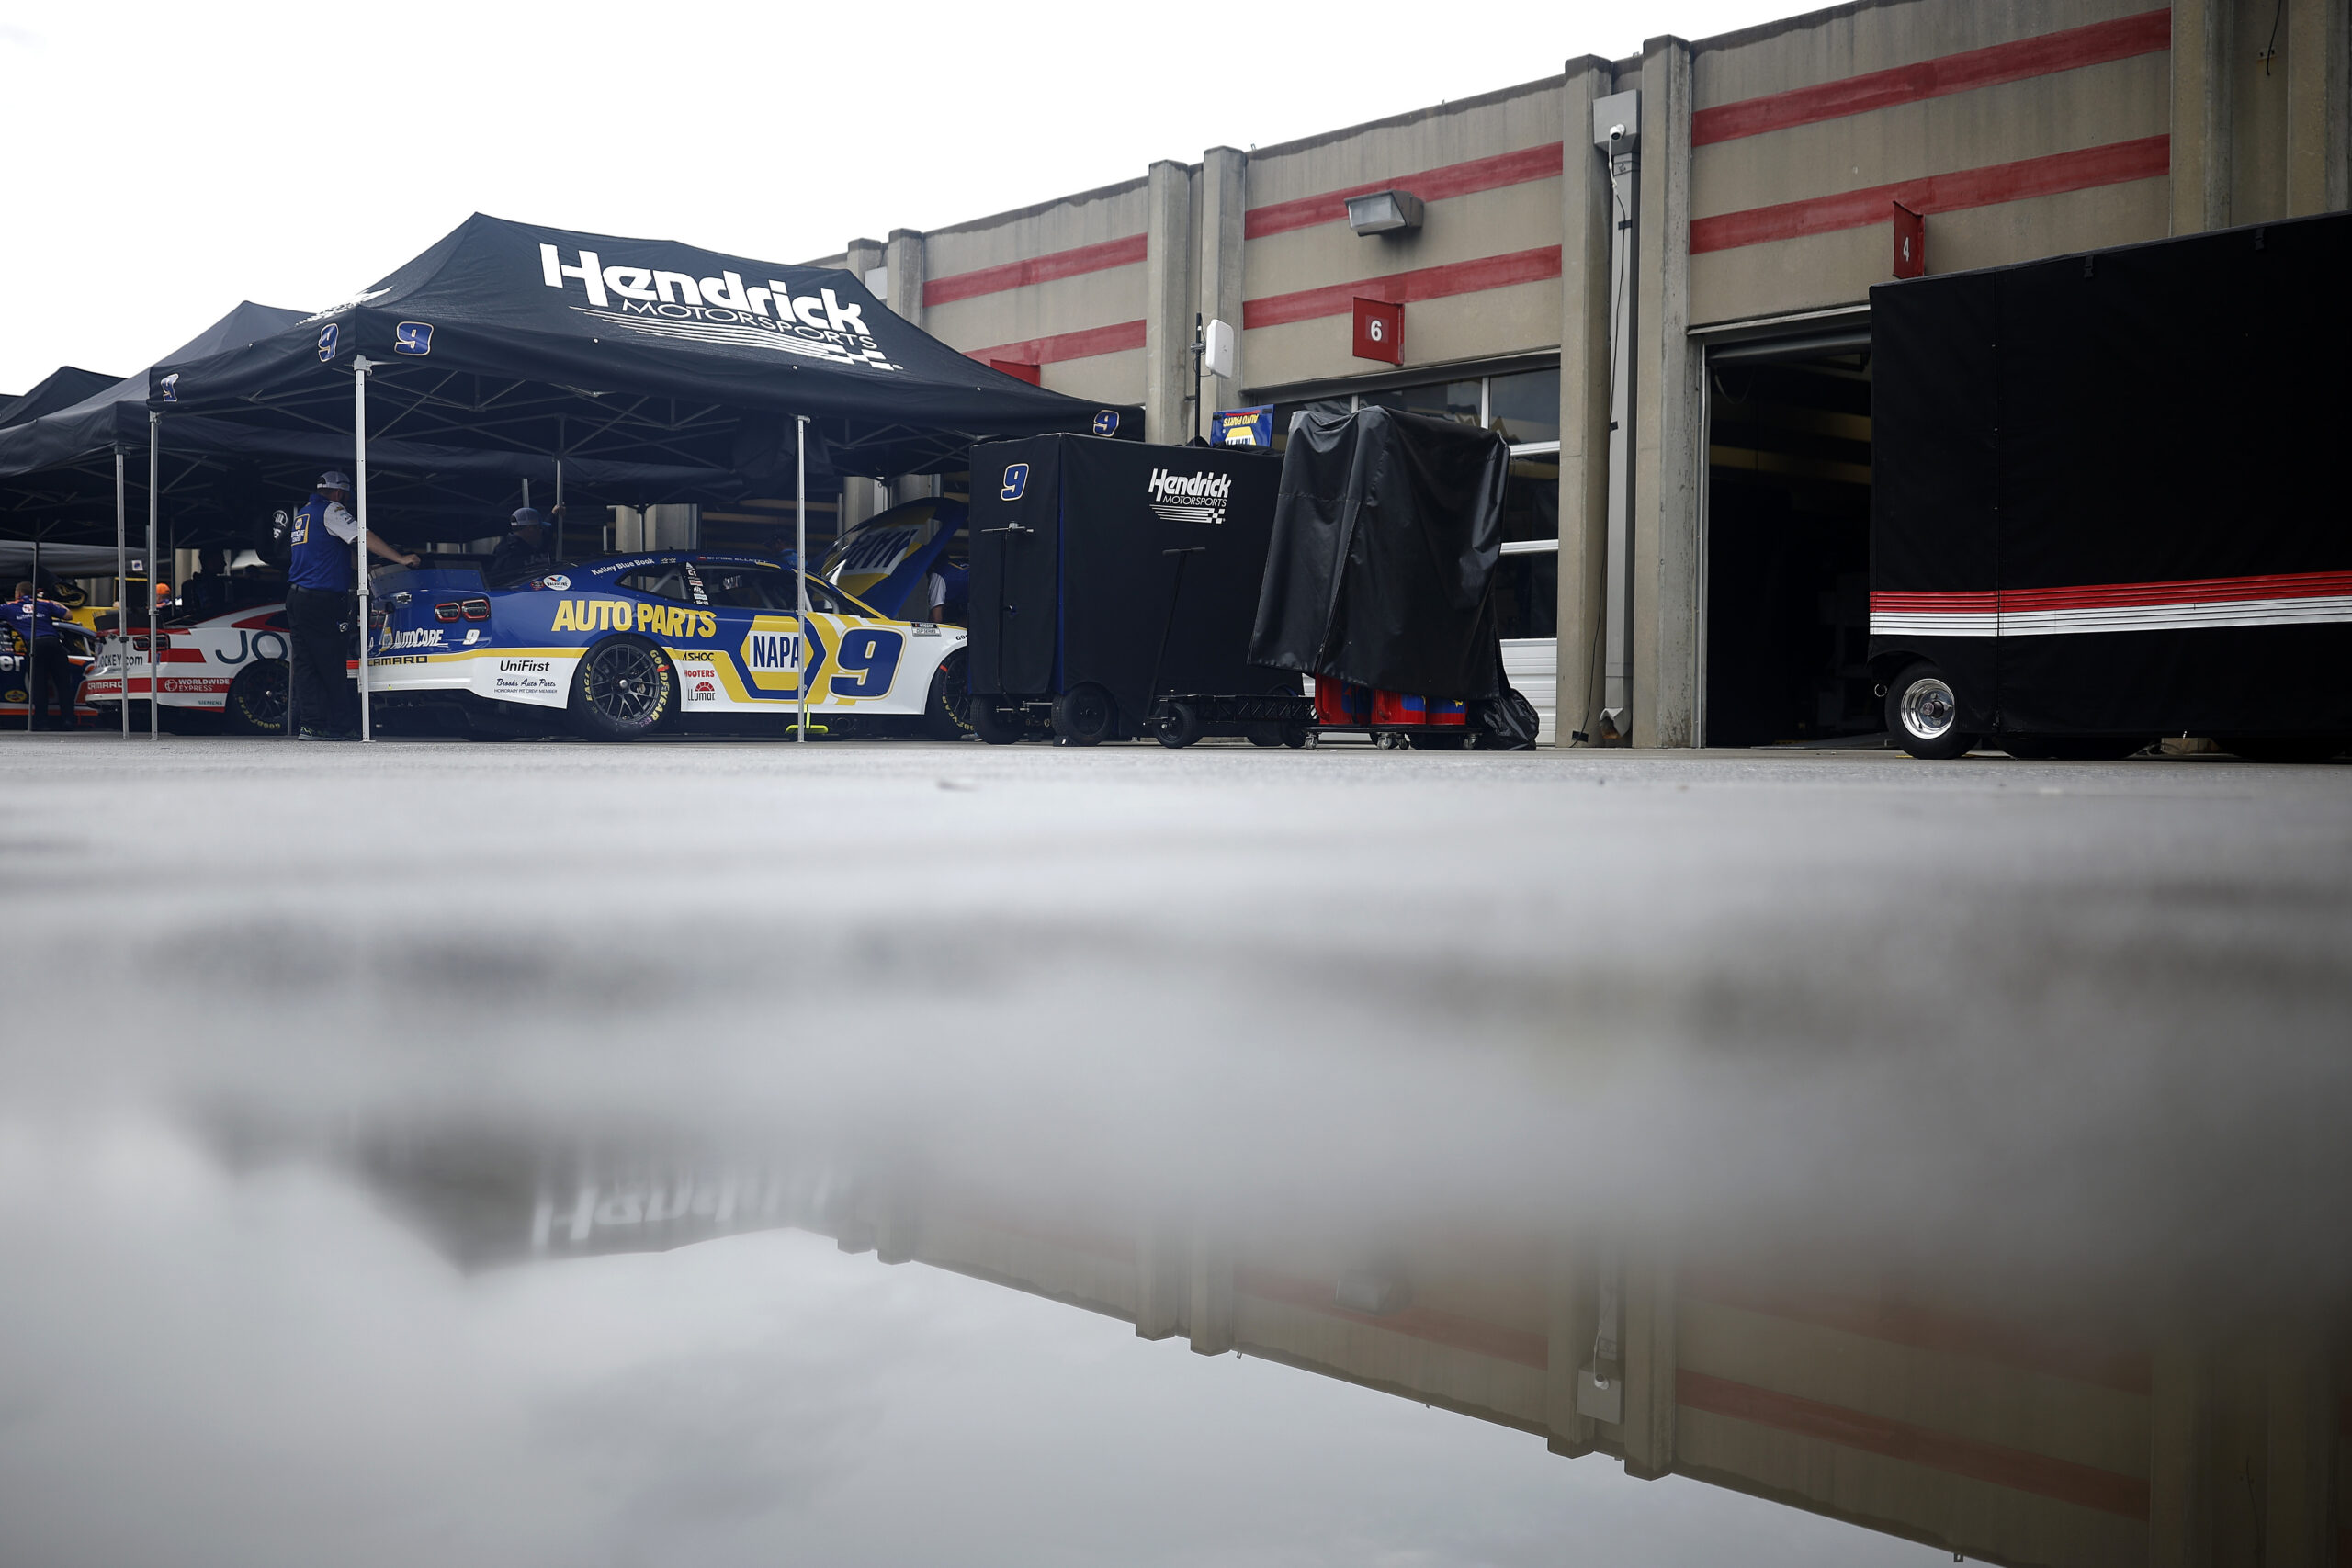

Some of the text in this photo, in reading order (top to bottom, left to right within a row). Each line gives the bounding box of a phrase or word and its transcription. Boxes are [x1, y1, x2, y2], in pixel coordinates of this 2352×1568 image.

[1903, 236, 1910, 263] 4
[539, 243, 871, 335] Hendrick
[622, 299, 878, 350] MOTORSPORTS
[1370, 320, 1383, 342] 6
[318, 322, 339, 363] 9
[394, 321, 435, 356] 9
[1092, 409, 1120, 437] 9
[1001, 462, 1030, 502] 9
[1148, 468, 1232, 502] Hendrick
[1162, 495, 1227, 507] MOTORSPORTS
[591, 565, 616, 576] Kelley
[616, 561, 634, 570] Blue
[634, 558, 655, 567] Book
[551, 600, 718, 638] AUTO PARTS
[462, 628, 481, 646] 9
[98, 653, 143, 669] JOCKEYcom
[368, 655, 428, 667] CAMARO
[500, 660, 550, 671] UniFirst
[684, 670, 715, 678] HOOTERS
[828, 626, 907, 701] 9
[496, 678, 556, 688] Brooks Auto Parts
[582, 663, 594, 702] EAGLE
